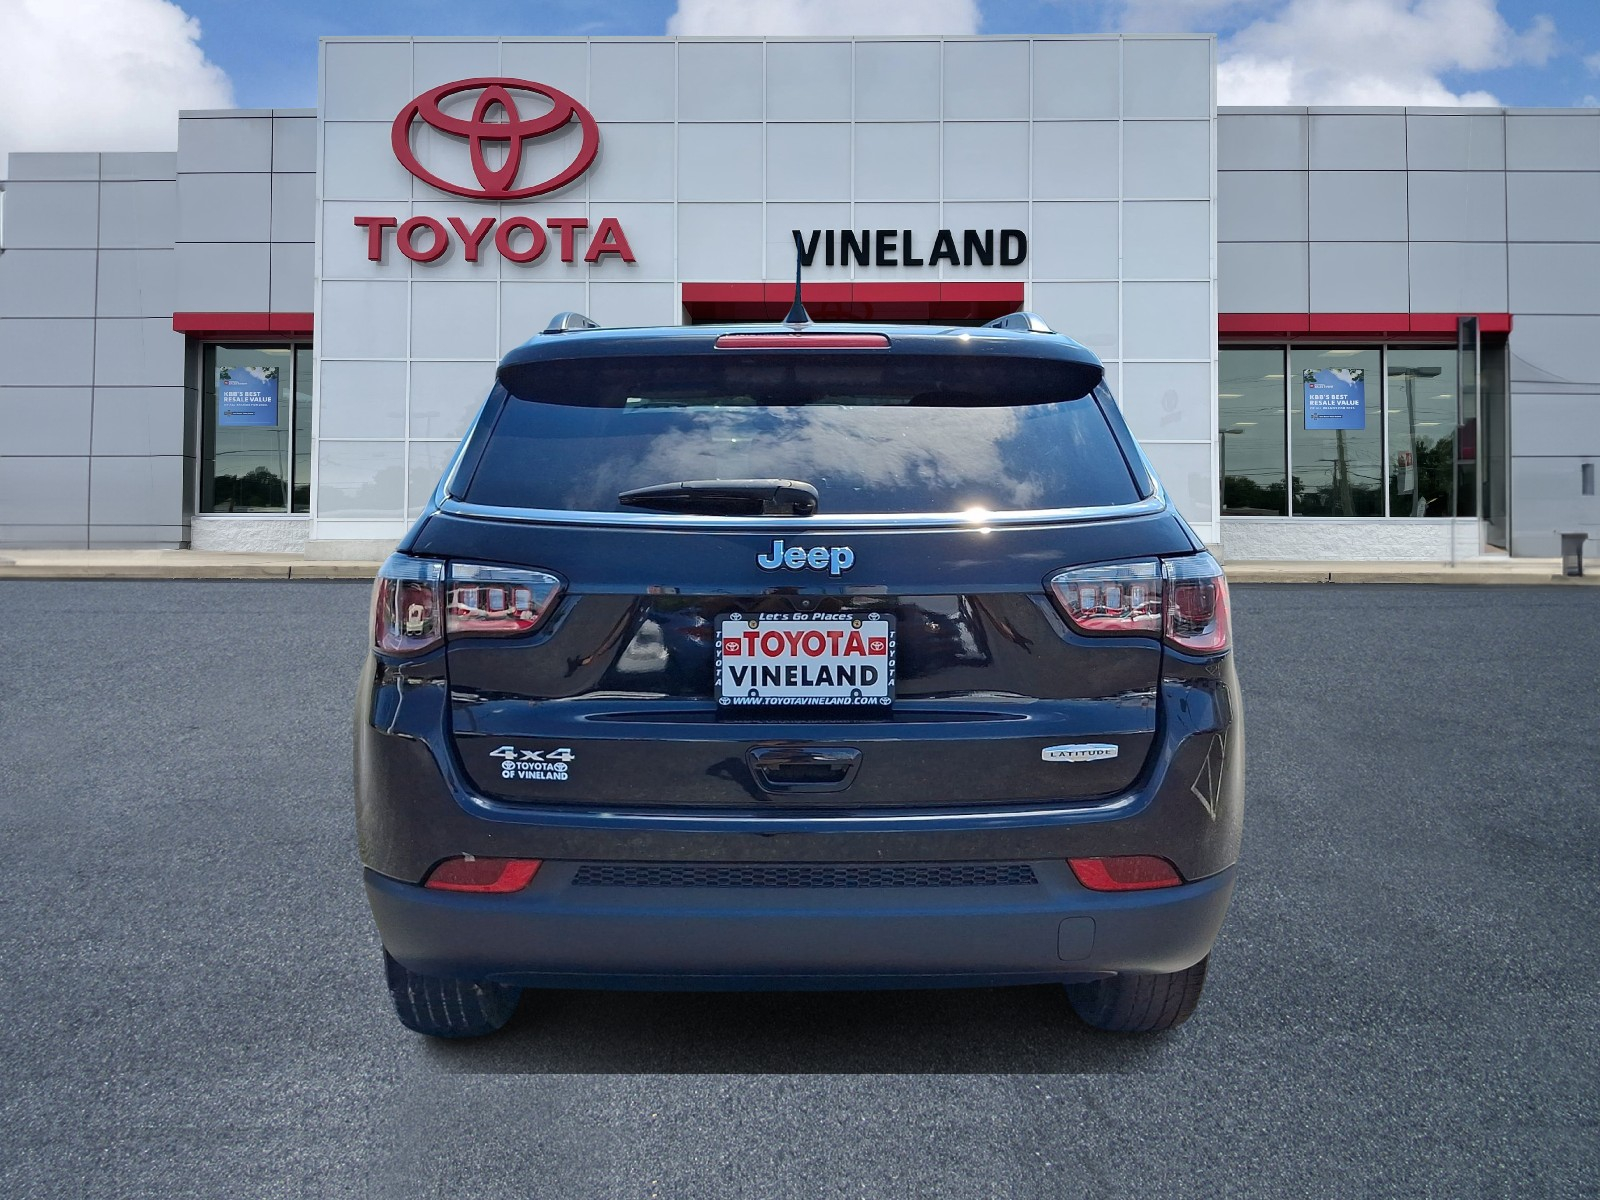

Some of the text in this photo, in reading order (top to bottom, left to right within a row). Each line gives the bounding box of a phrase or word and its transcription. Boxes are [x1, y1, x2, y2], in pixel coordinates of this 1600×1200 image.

[354, 216, 635, 264] TOYOTA
[792, 229, 1028, 266] VINELAND
[757, 540, 854, 575] Jeep
[758, 612, 853, 621] Let's Go Places
[743, 630, 867, 657] TOYOTA
[714, 631, 723, 687] TOYOTA
[887, 631, 896, 687] TOYOTA
[728, 665, 879, 687] VINELAND
[733, 696, 878, 706] WWW.TOYOTAVINELAND.COM
[1050, 750, 1111, 758] LATITUDE
[502, 770, 568, 780] OF VINELAND
[516, 762, 554, 771] TOYOTA
